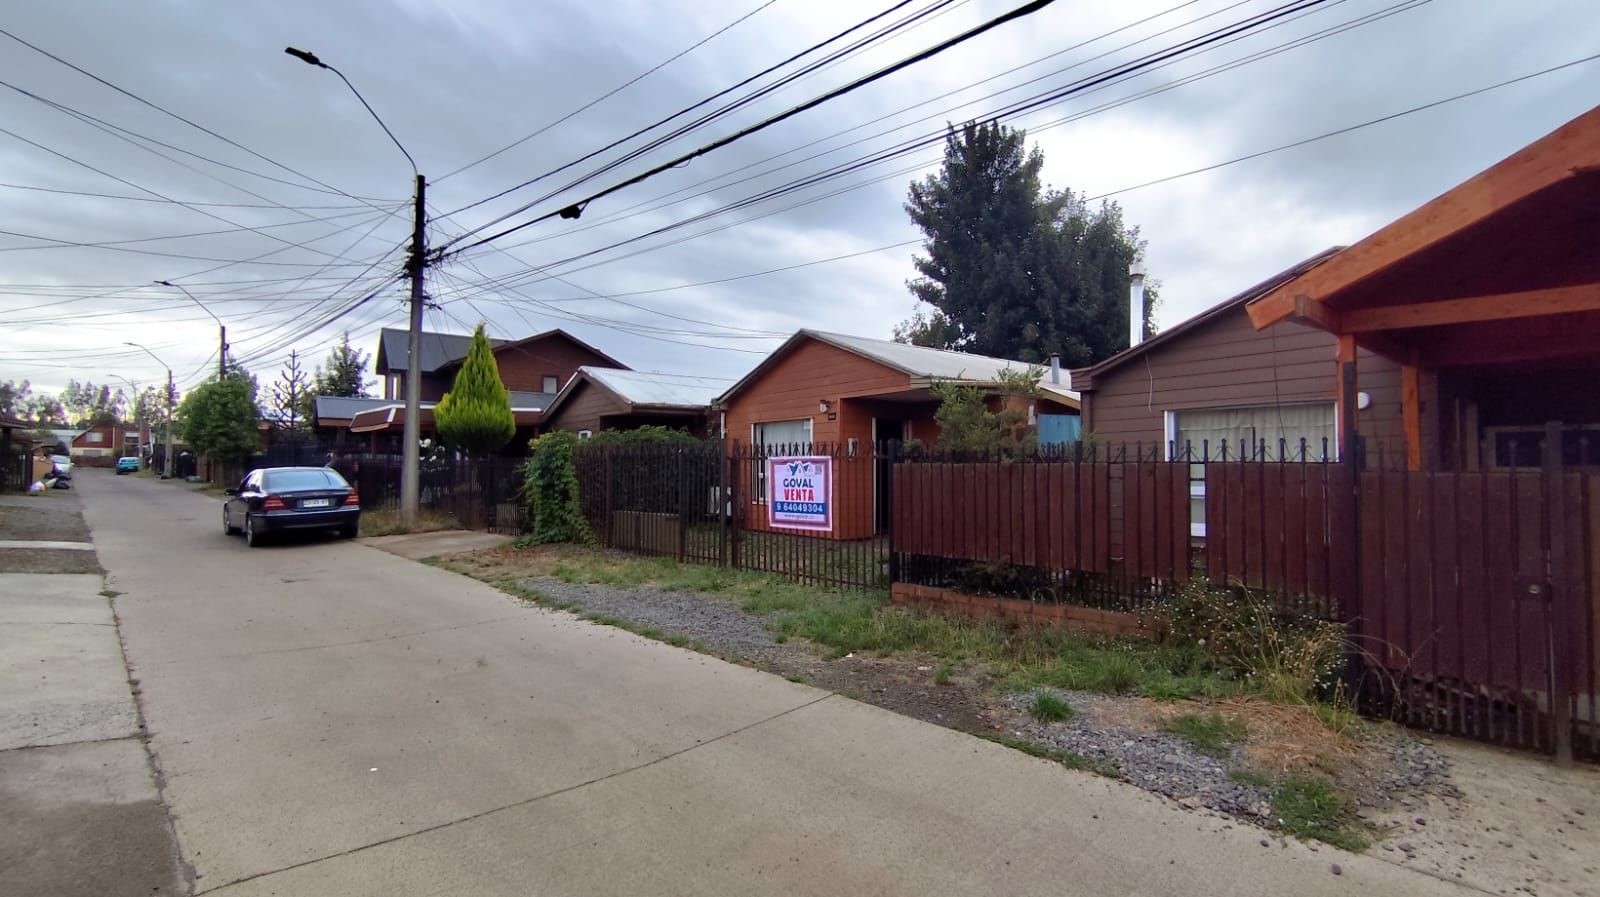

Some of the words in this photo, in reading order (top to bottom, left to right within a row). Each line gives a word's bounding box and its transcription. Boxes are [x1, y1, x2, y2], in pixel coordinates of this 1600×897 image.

[783, 478, 814, 488] GOVAL
[784, 489, 814, 501] VENTA
[776, 502, 781, 511] 9
[783, 502, 823, 513] 64049304
